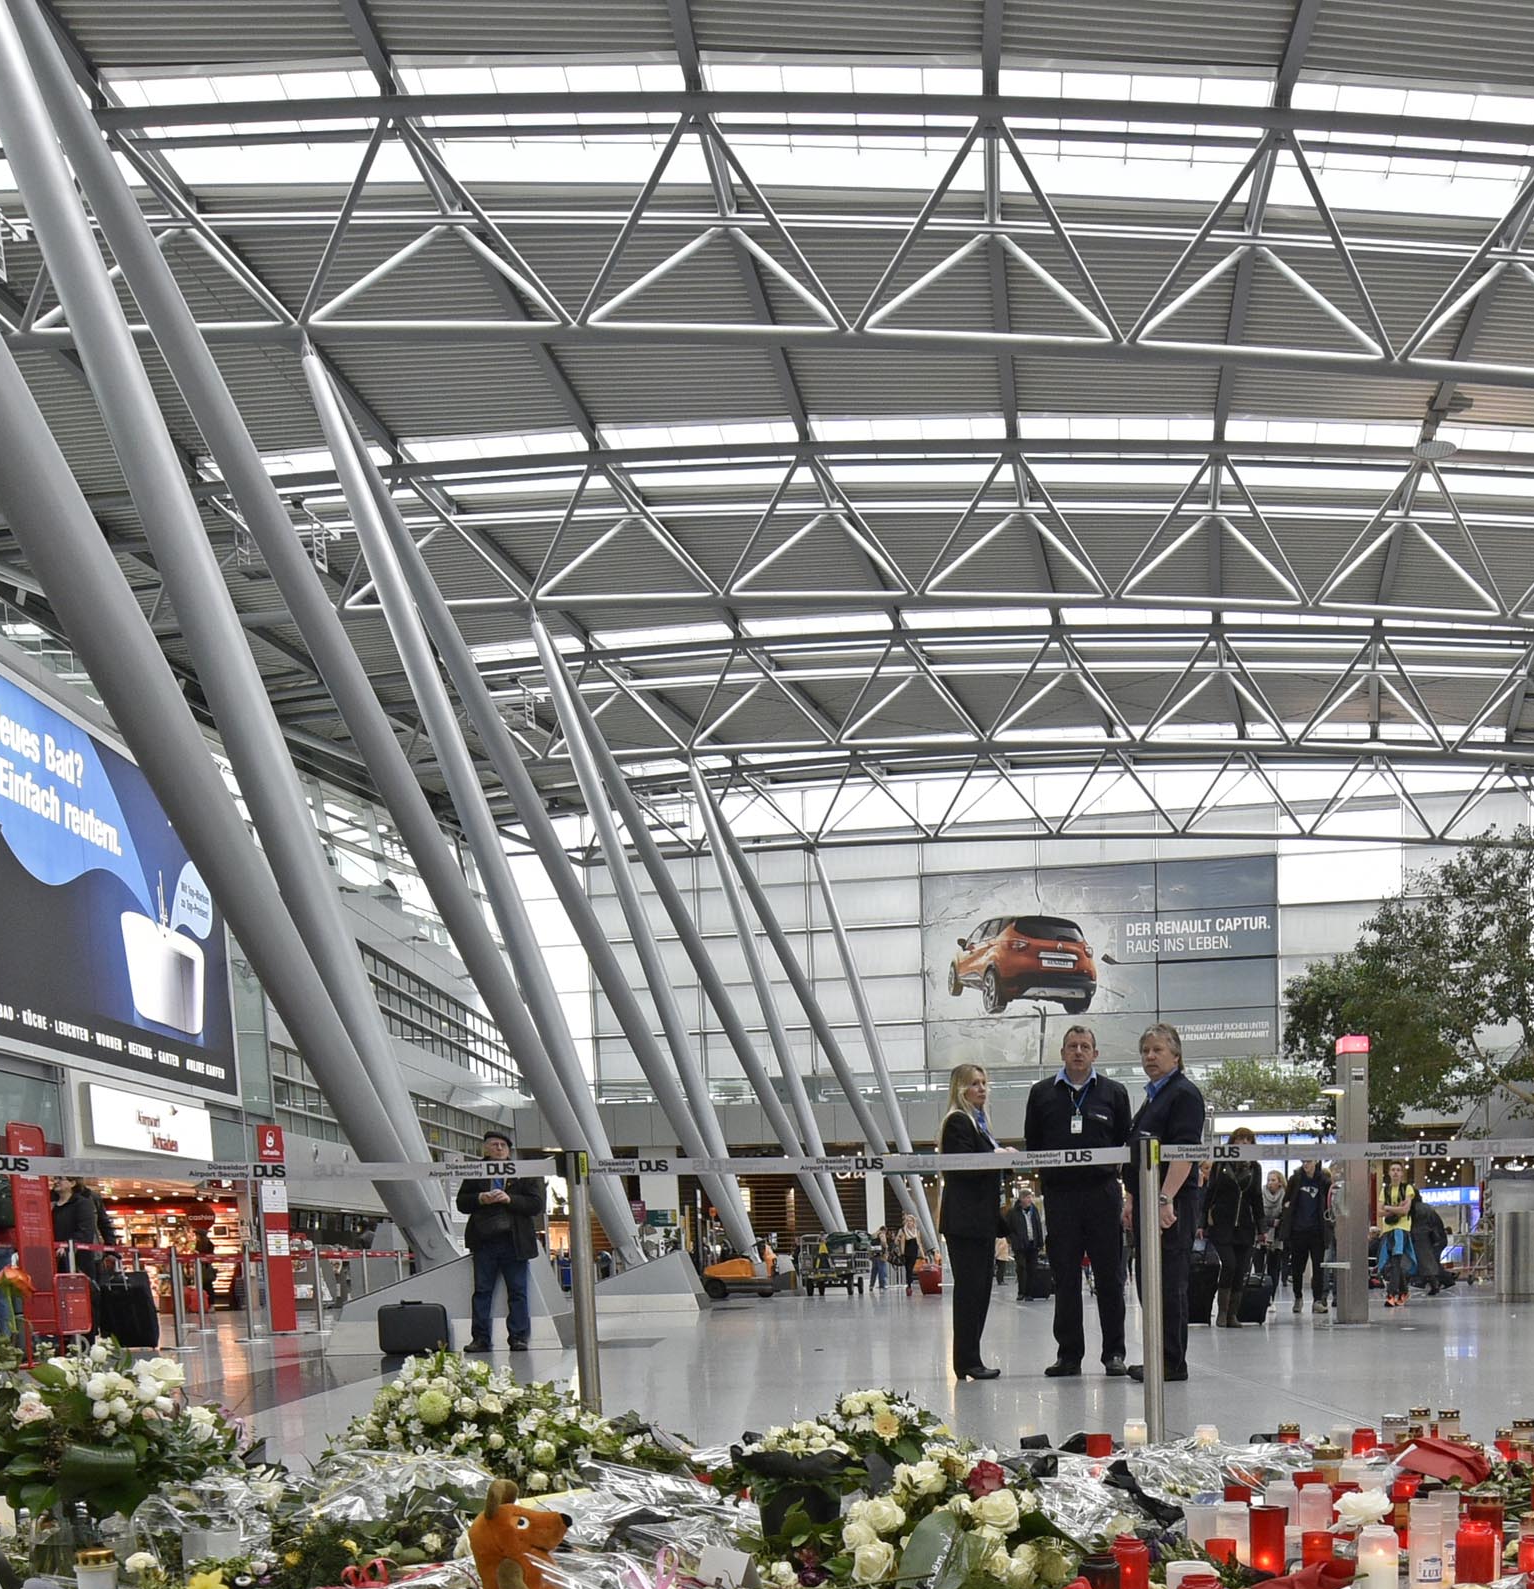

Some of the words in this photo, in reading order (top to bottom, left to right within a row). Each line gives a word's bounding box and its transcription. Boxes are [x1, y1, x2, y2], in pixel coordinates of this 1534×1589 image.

[44, 734, 83, 788] Bad?
[65, 802, 122, 856] reutern.
[1126, 923, 1151, 937] DER
[1154, 919, 1212, 936] RENAULT
[1215, 916, 1271, 932] CAPTUR.
[1126, 939, 1160, 954] RAUS
[1164, 938, 1184, 953] INS
[1188, 935, 1232, 951] LEBEN.
[22, 1009, 48, 1030] KÜCHE
[1065, 1149, 1092, 1163] DUS
[1213, 1145, 1241, 1159] DUS
[1419, 1143, 1448, 1155] DUS
[486, 1162, 516, 1176] DUS
[638, 1159, 668, 1173] DUS
[854, 1157, 884, 1170] DUS
[253, 1165, 285, 1178] DUS
